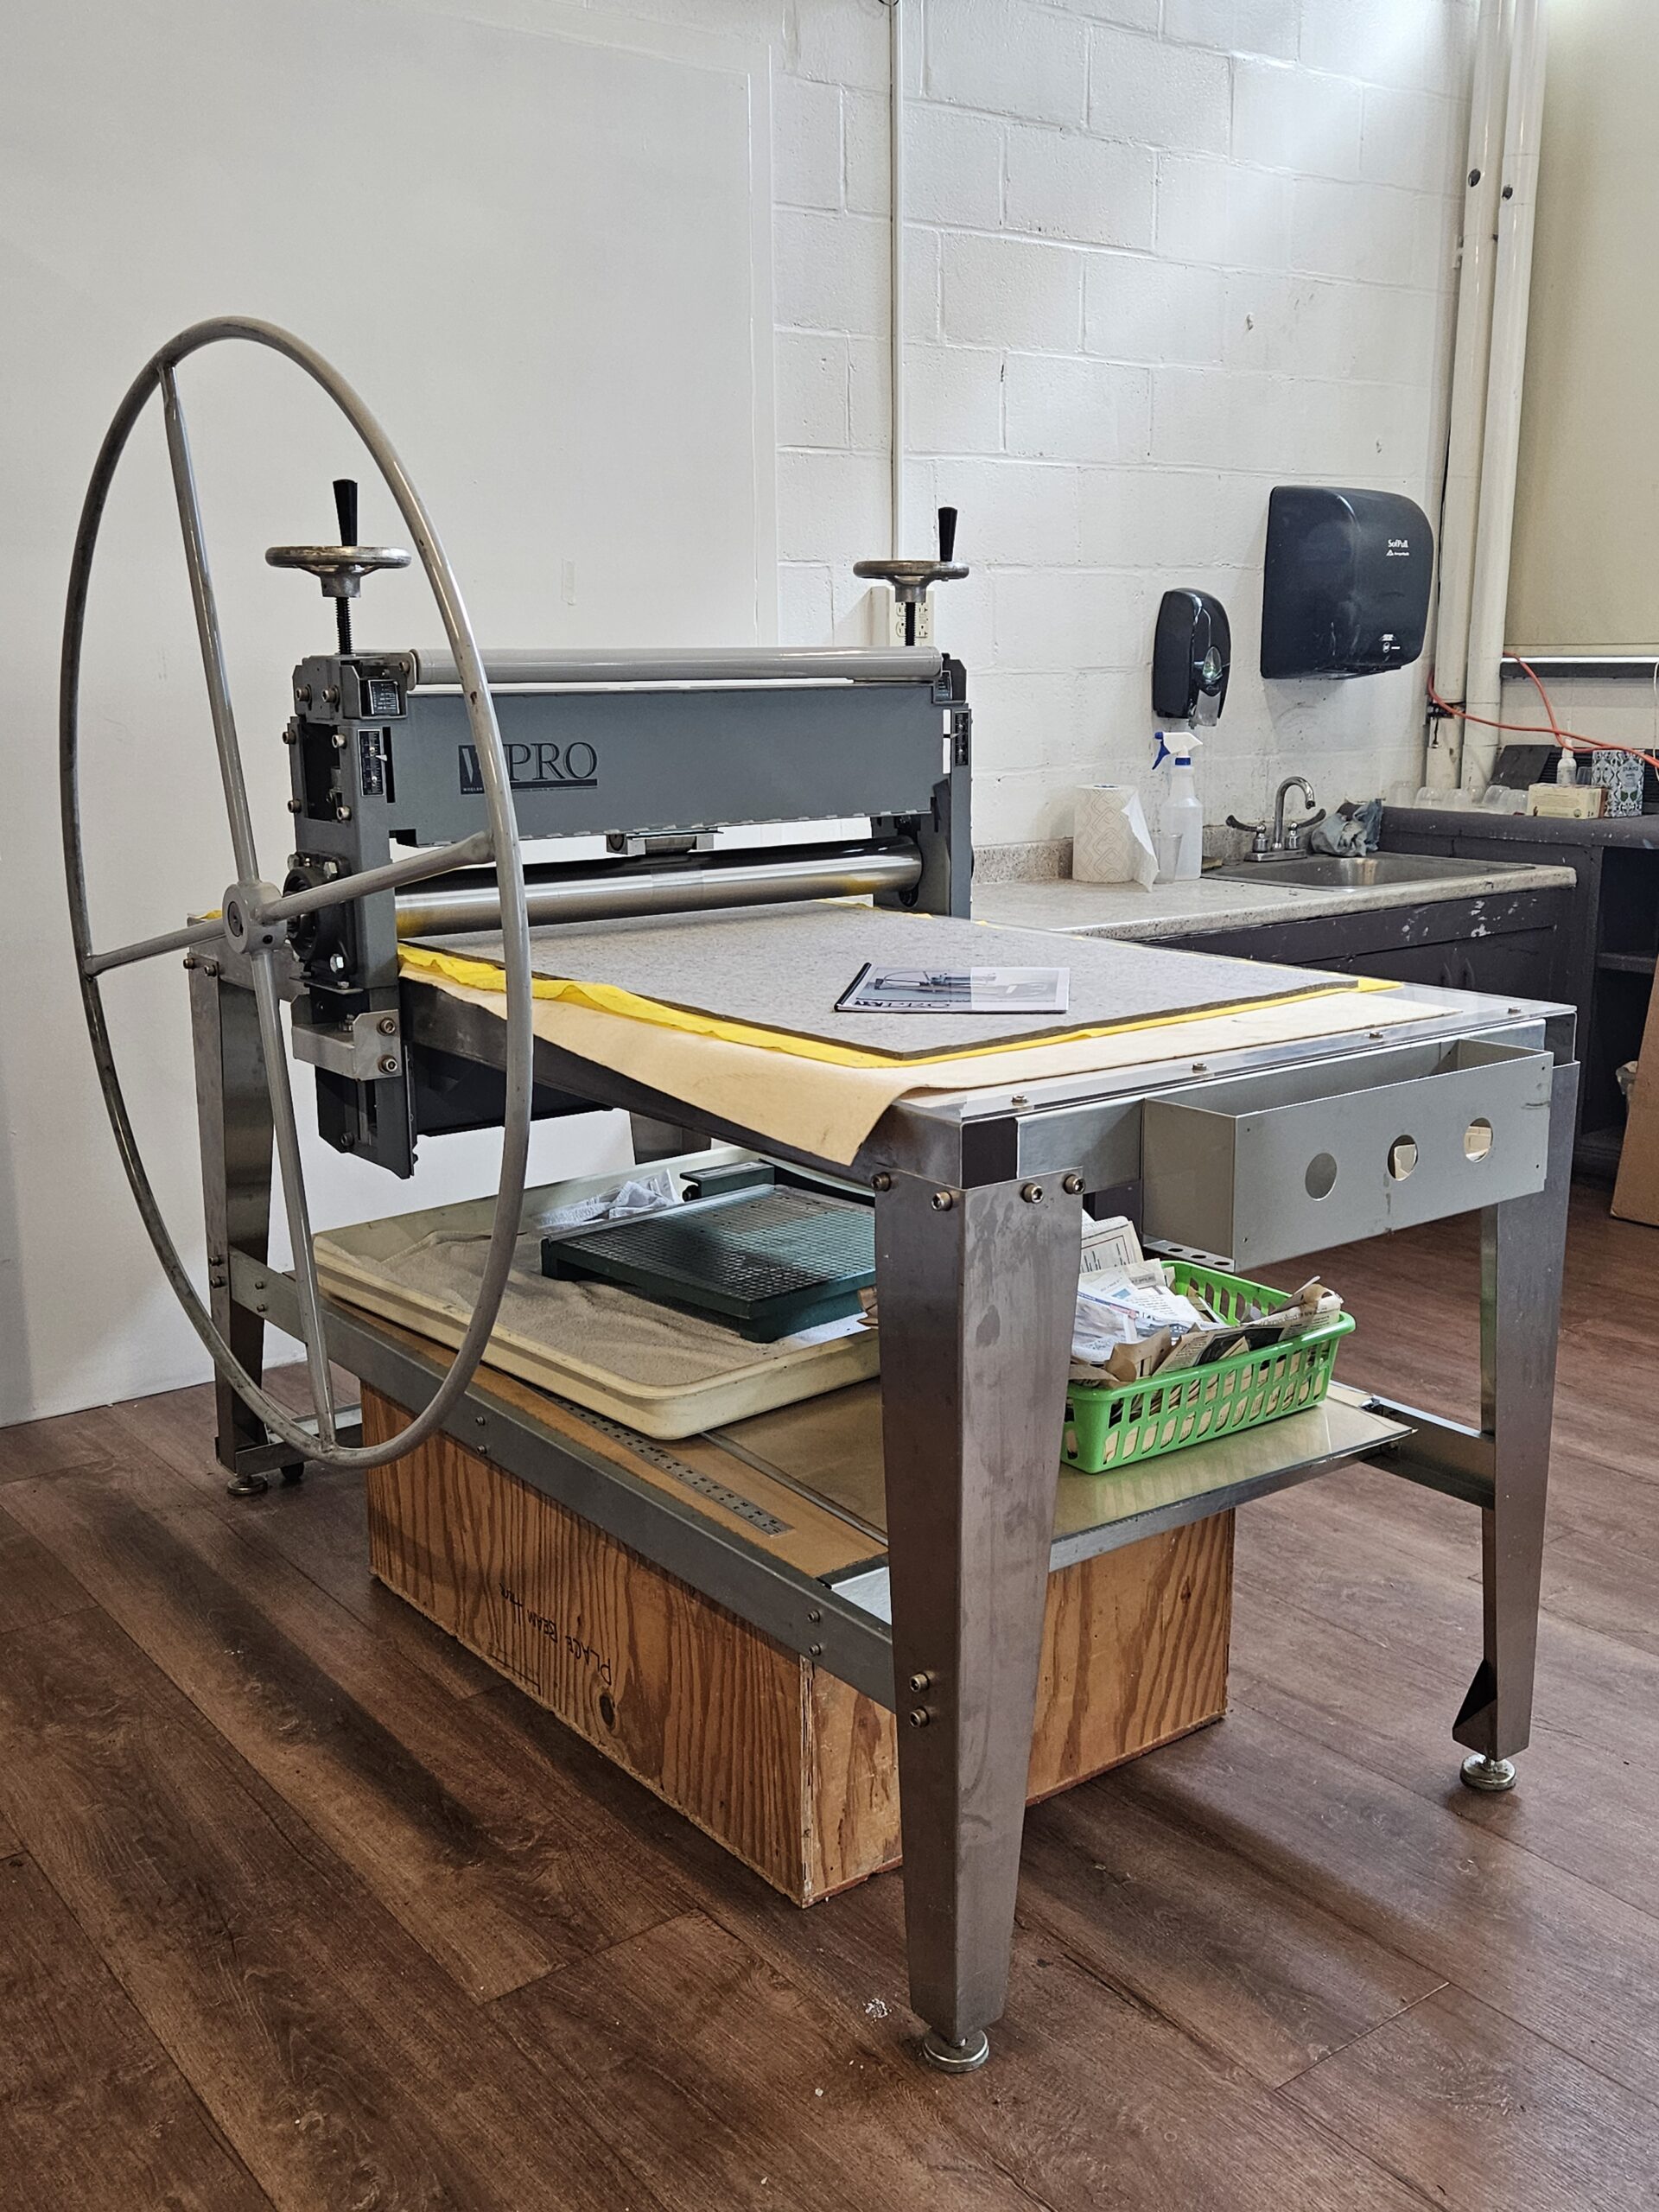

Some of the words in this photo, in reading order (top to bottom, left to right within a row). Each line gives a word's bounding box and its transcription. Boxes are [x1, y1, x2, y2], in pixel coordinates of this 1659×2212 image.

[503, 741, 598, 781] PRO
[527, 1609, 558, 1643] BEAM
[565, 1635, 613, 1686] PLACE
